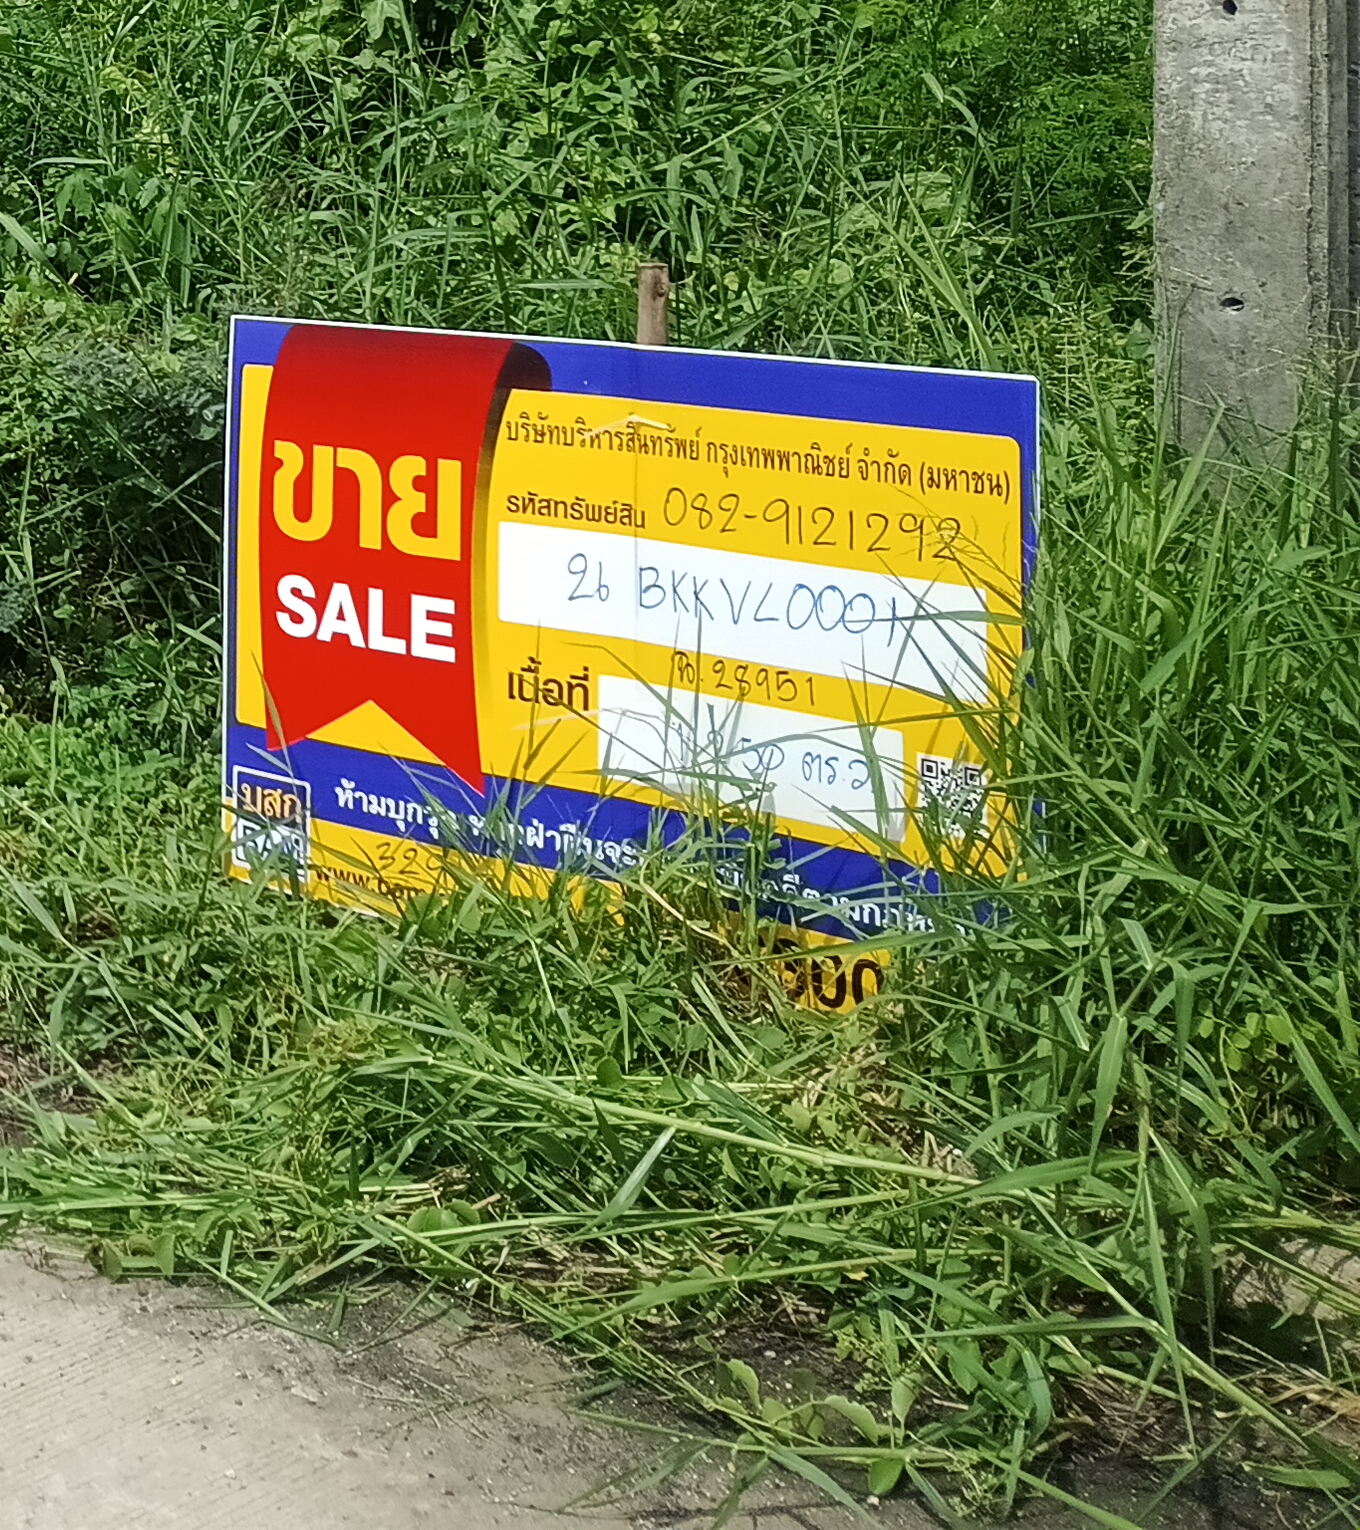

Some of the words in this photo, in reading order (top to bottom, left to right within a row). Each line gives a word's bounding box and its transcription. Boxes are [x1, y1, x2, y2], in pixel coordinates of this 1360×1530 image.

[273, 439, 462, 562] ขาย
[706, 441, 853, 478] กรุงเทพพาณิชย์
[856, 447, 912, 486] จำกัด
[919, 461, 1011, 505] (มหาชน)
[506, 490, 647, 530] รหัสทรัพย์สิน
[663, 486, 961, 563] 082-9121292
[275, 574, 457, 664] SALE
[507, 655, 590, 712] เนื้อที่
